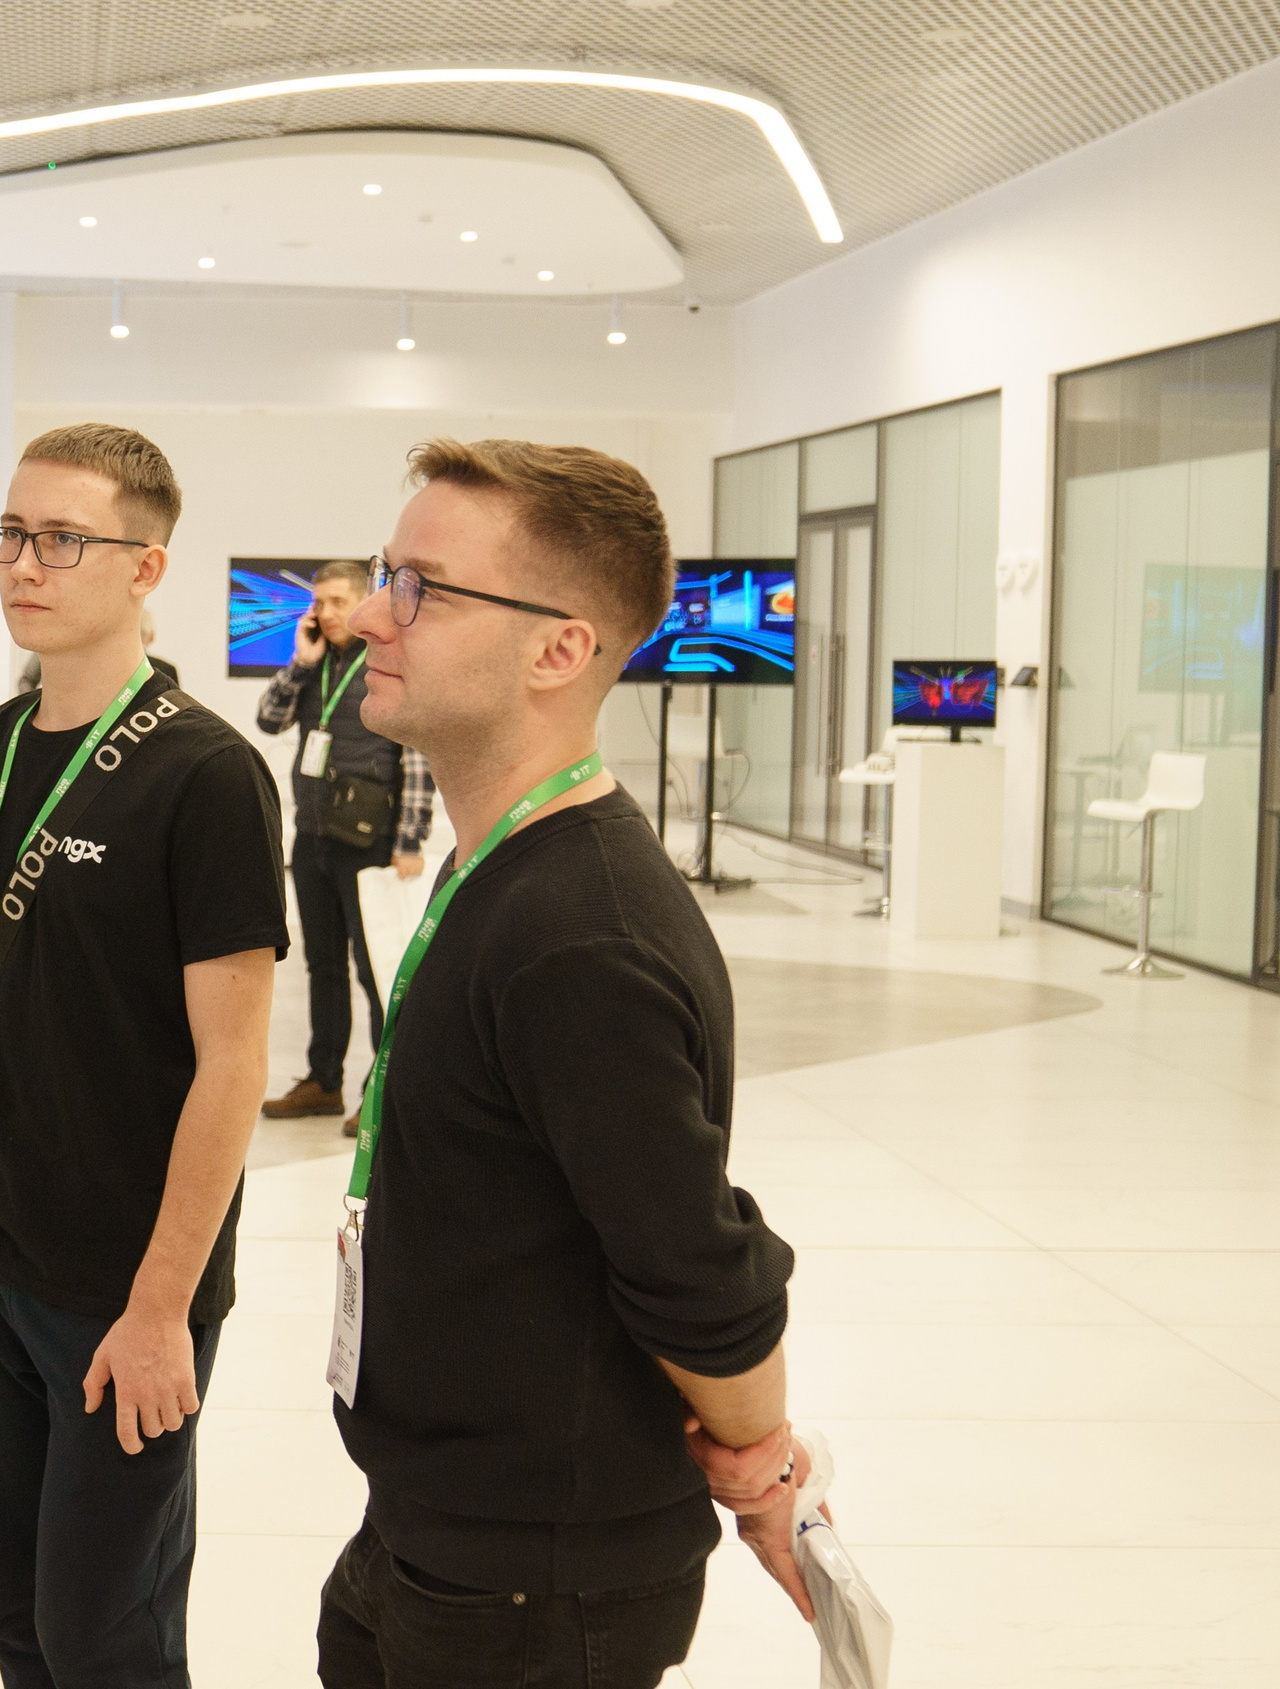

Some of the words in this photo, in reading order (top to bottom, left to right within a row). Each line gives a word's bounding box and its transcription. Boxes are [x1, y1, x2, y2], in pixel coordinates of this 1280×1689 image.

[95, 696, 180, 771] POLO
[2, 828, 59, 920] POLO
[58, 836, 106, 864] ngx
